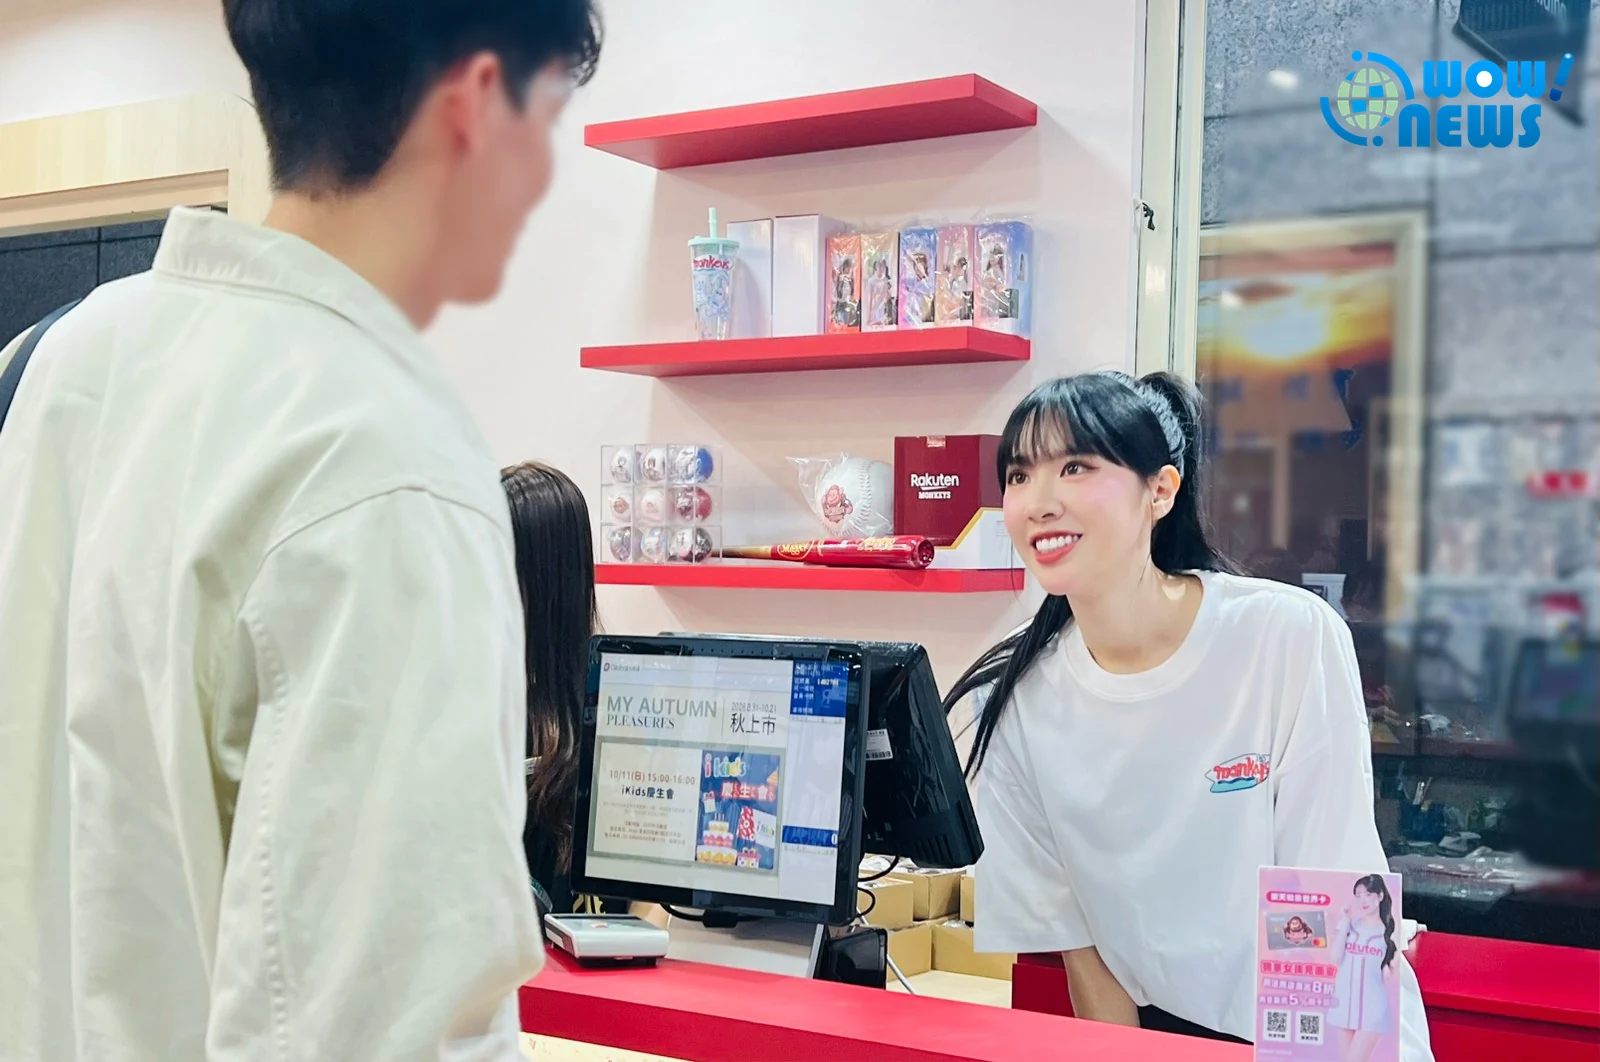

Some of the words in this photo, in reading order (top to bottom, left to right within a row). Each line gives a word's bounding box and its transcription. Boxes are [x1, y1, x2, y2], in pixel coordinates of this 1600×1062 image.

[911, 473, 960, 487] Rakuten
[918, 491, 951, 499] MONKEYS
[779, 543, 809, 556] Slugger
[607, 696, 633, 714] MY
[639, 697, 717, 718] AUTUMN
[606, 714, 675, 729] PLEASURES
[730, 713, 777, 735] 秋上市
